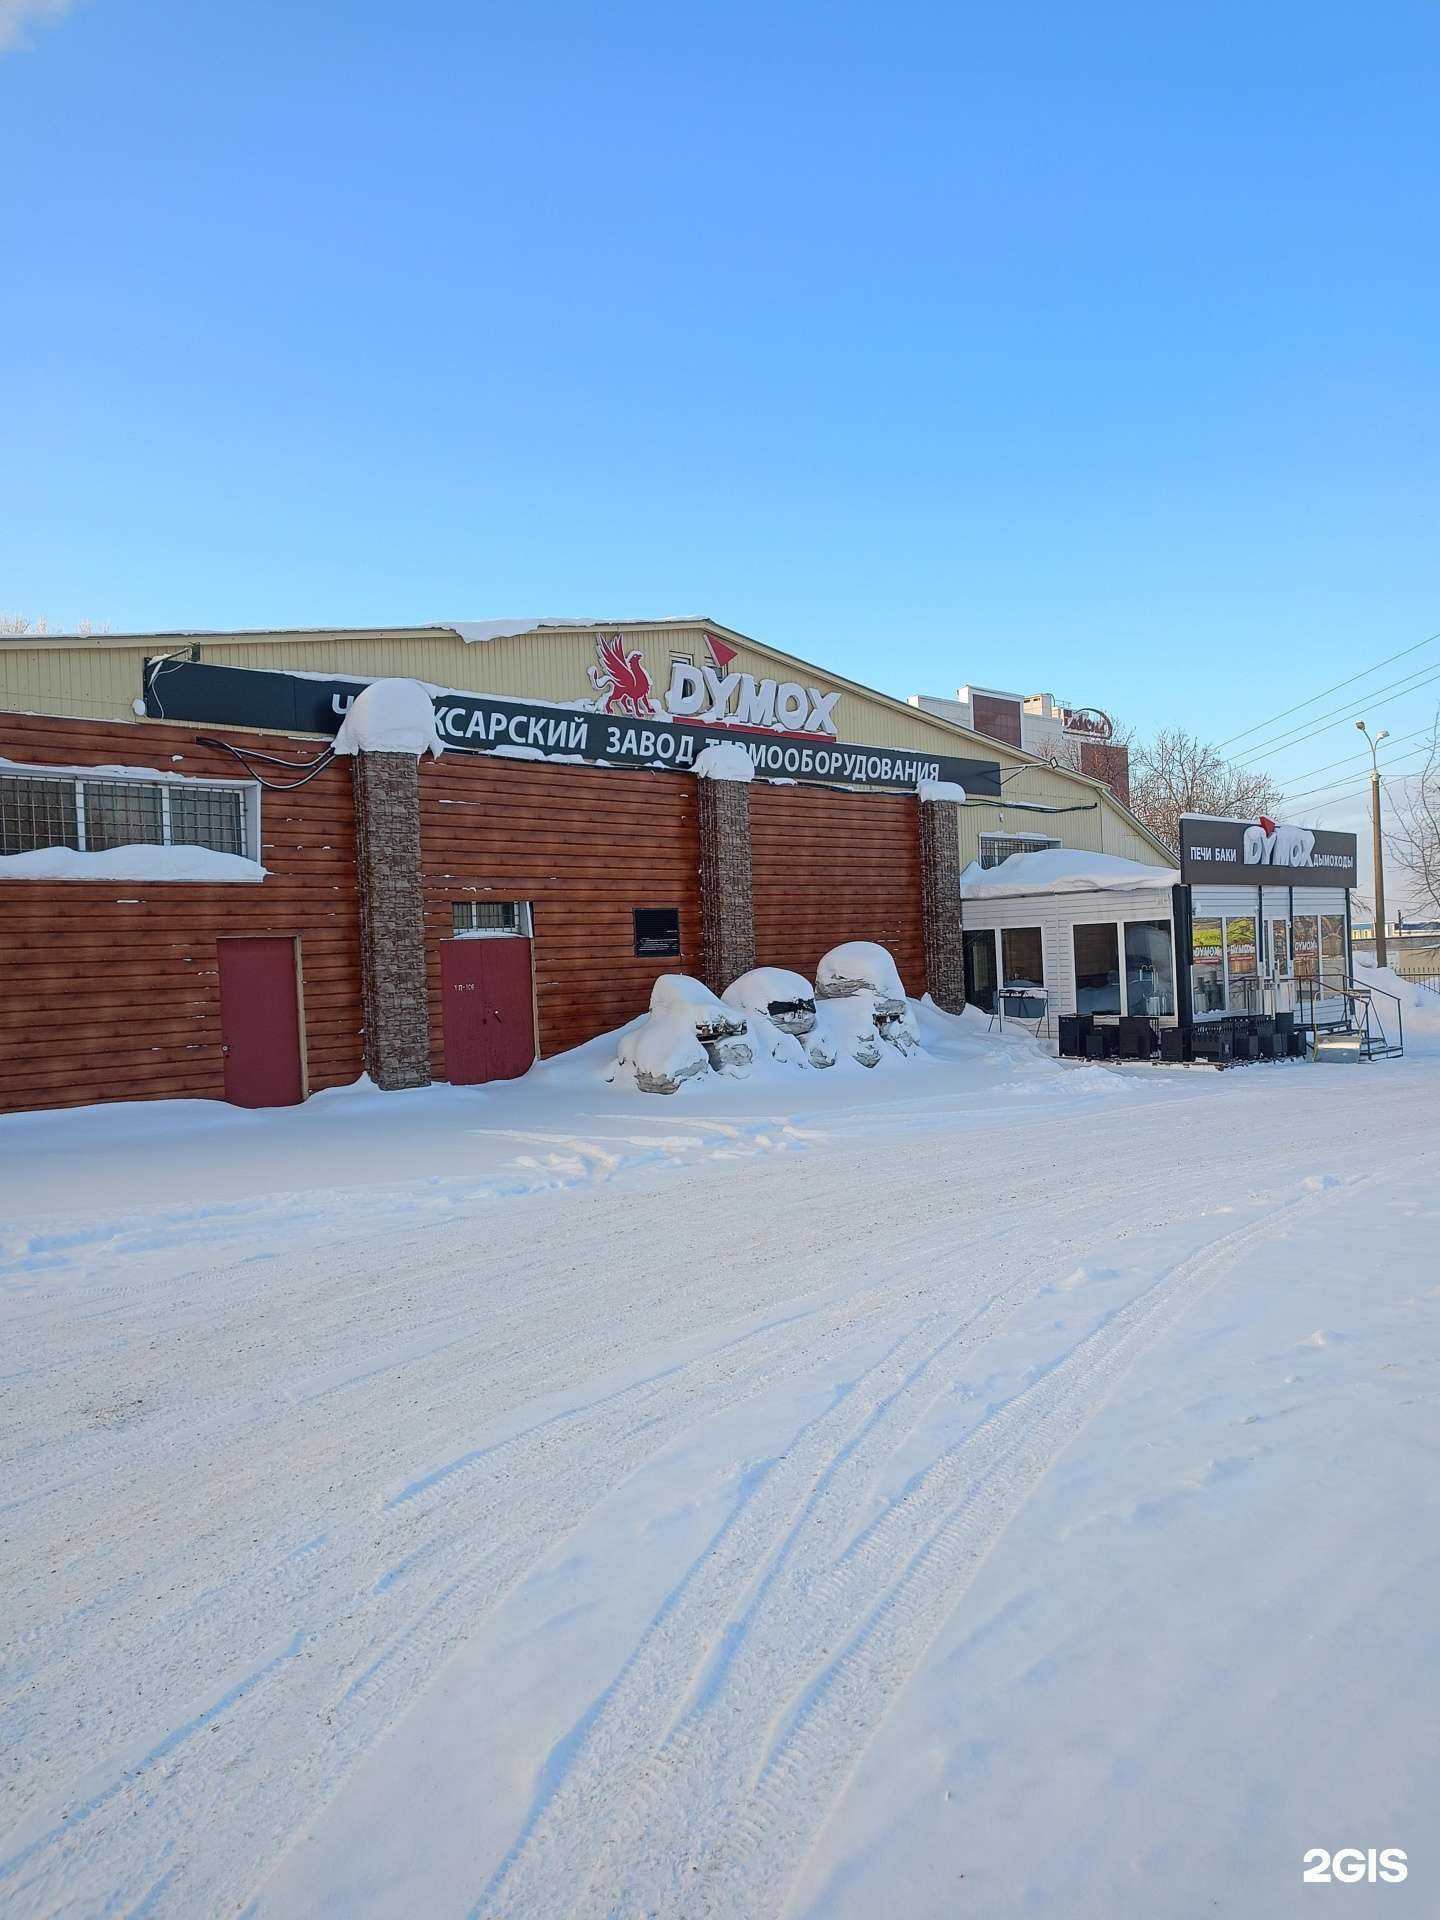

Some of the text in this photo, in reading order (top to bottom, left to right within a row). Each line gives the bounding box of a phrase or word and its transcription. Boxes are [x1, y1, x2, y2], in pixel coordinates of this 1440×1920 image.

[665, 663, 840, 735] DYMOX
[331, 693, 588, 750] ЧКСАРСКИЙ
[606, 726, 694, 765] ЗАВОД
[1190, 847, 1237, 862] ПЕЧИ БАКИ
[1313, 852, 1354, 868] ДЫМОХОДЫ
